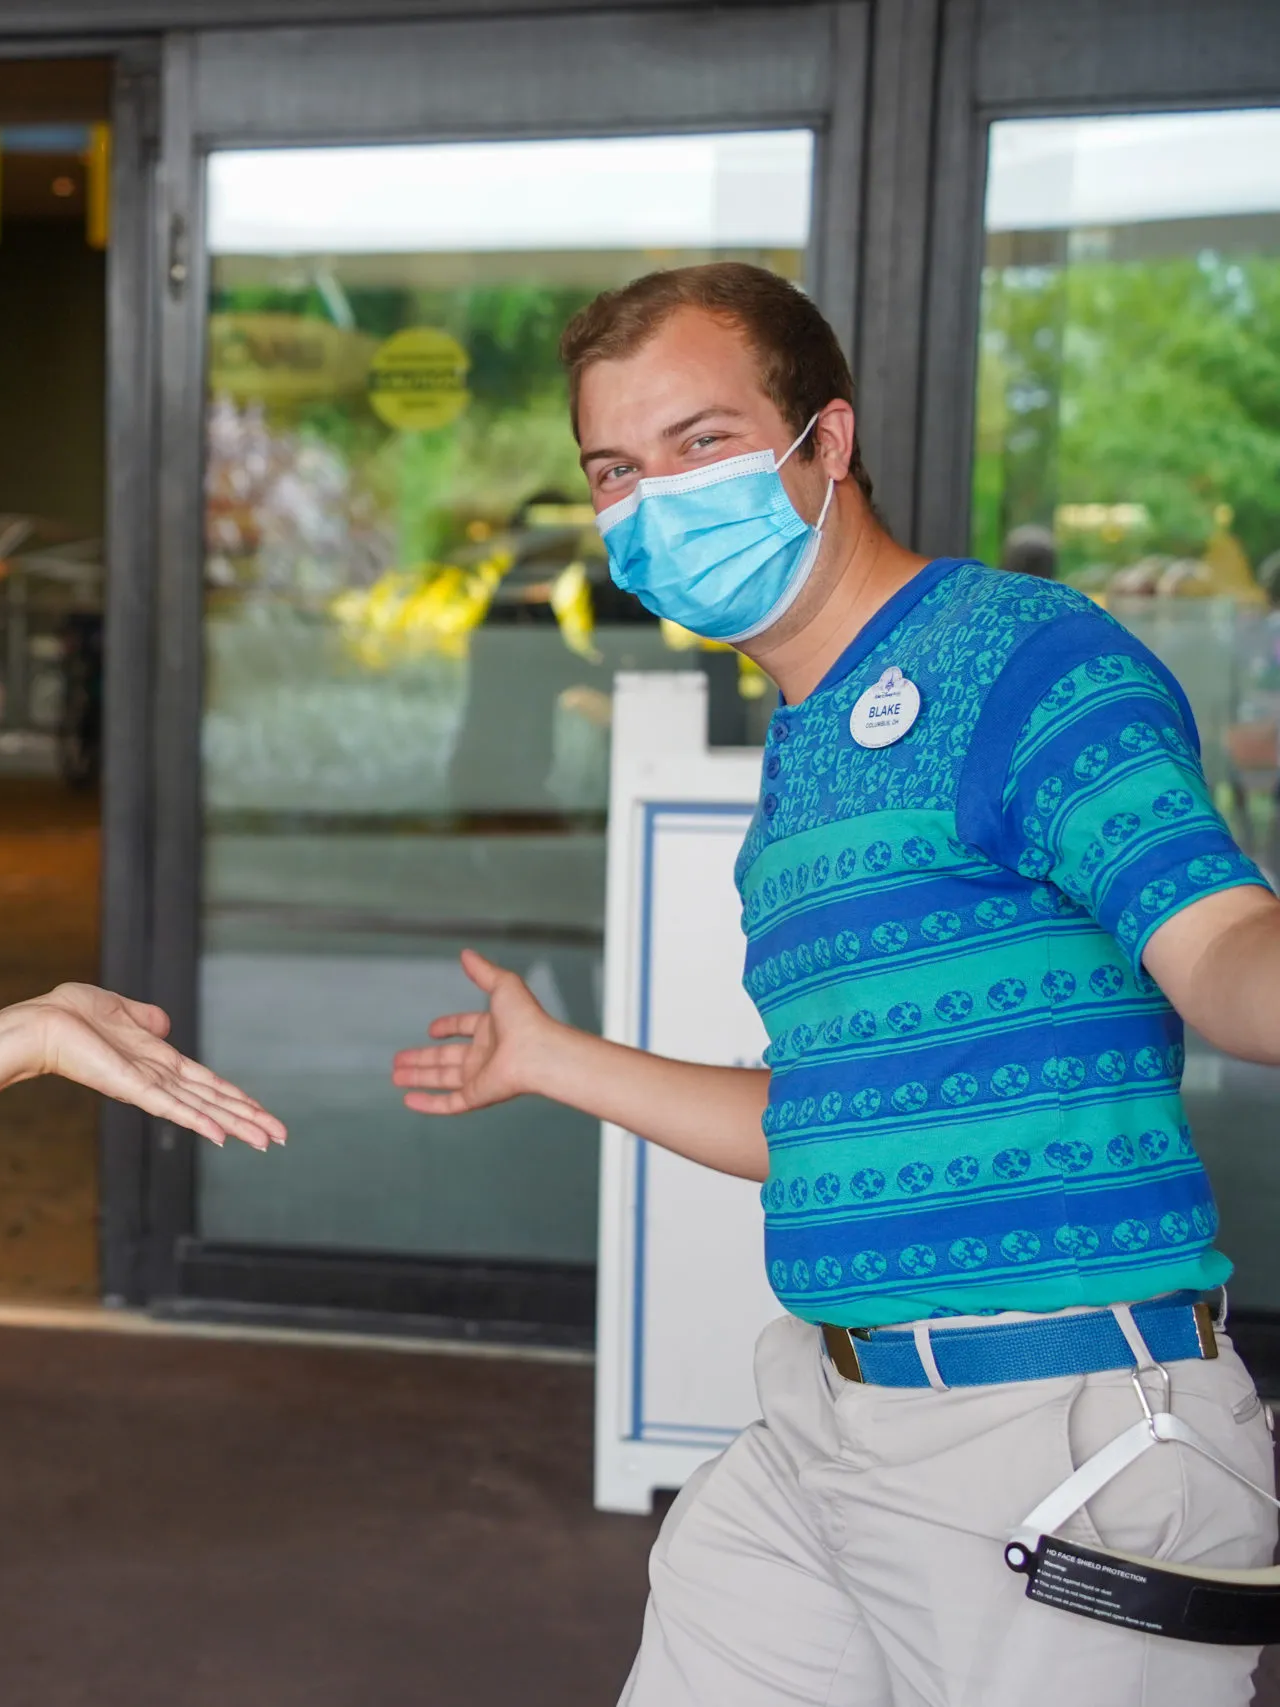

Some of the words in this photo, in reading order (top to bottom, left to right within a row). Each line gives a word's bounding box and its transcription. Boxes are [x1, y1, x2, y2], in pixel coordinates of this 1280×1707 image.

[869, 703, 901, 718] BLAKE
[1046, 1548, 1057, 1557] HD
[1057, 1551, 1075, 1563] FACE
[1076, 1557, 1100, 1570] SHIELD
